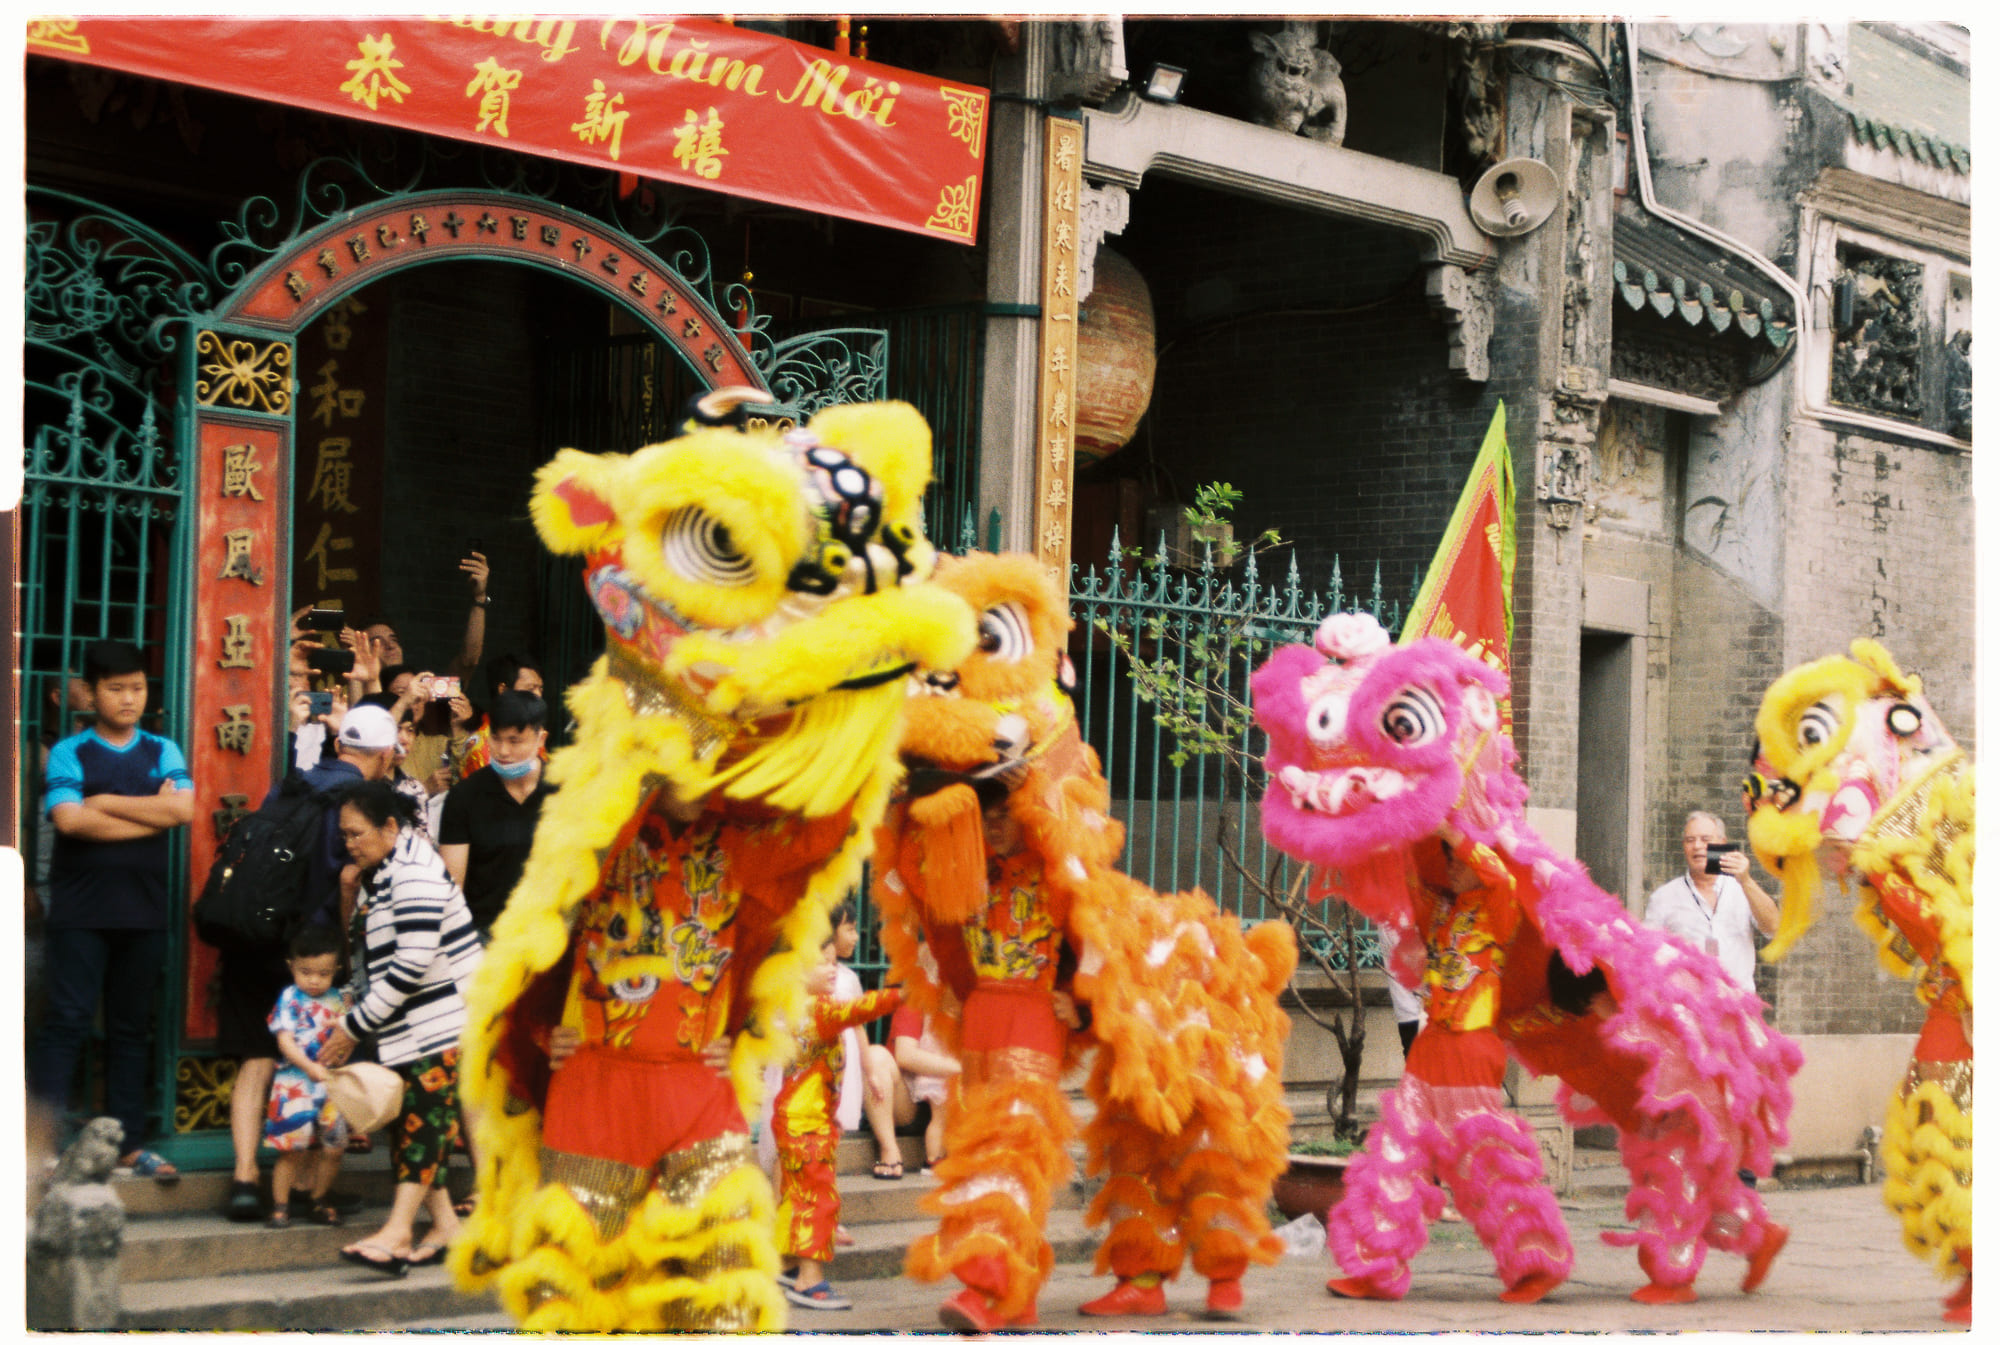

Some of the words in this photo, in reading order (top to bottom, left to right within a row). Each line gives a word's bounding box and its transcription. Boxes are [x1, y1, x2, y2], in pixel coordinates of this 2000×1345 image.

[340, 33, 730, 179] 恭賀新禧
[600, 17, 767, 96] Năm
[776, 59, 901, 127] Mới
